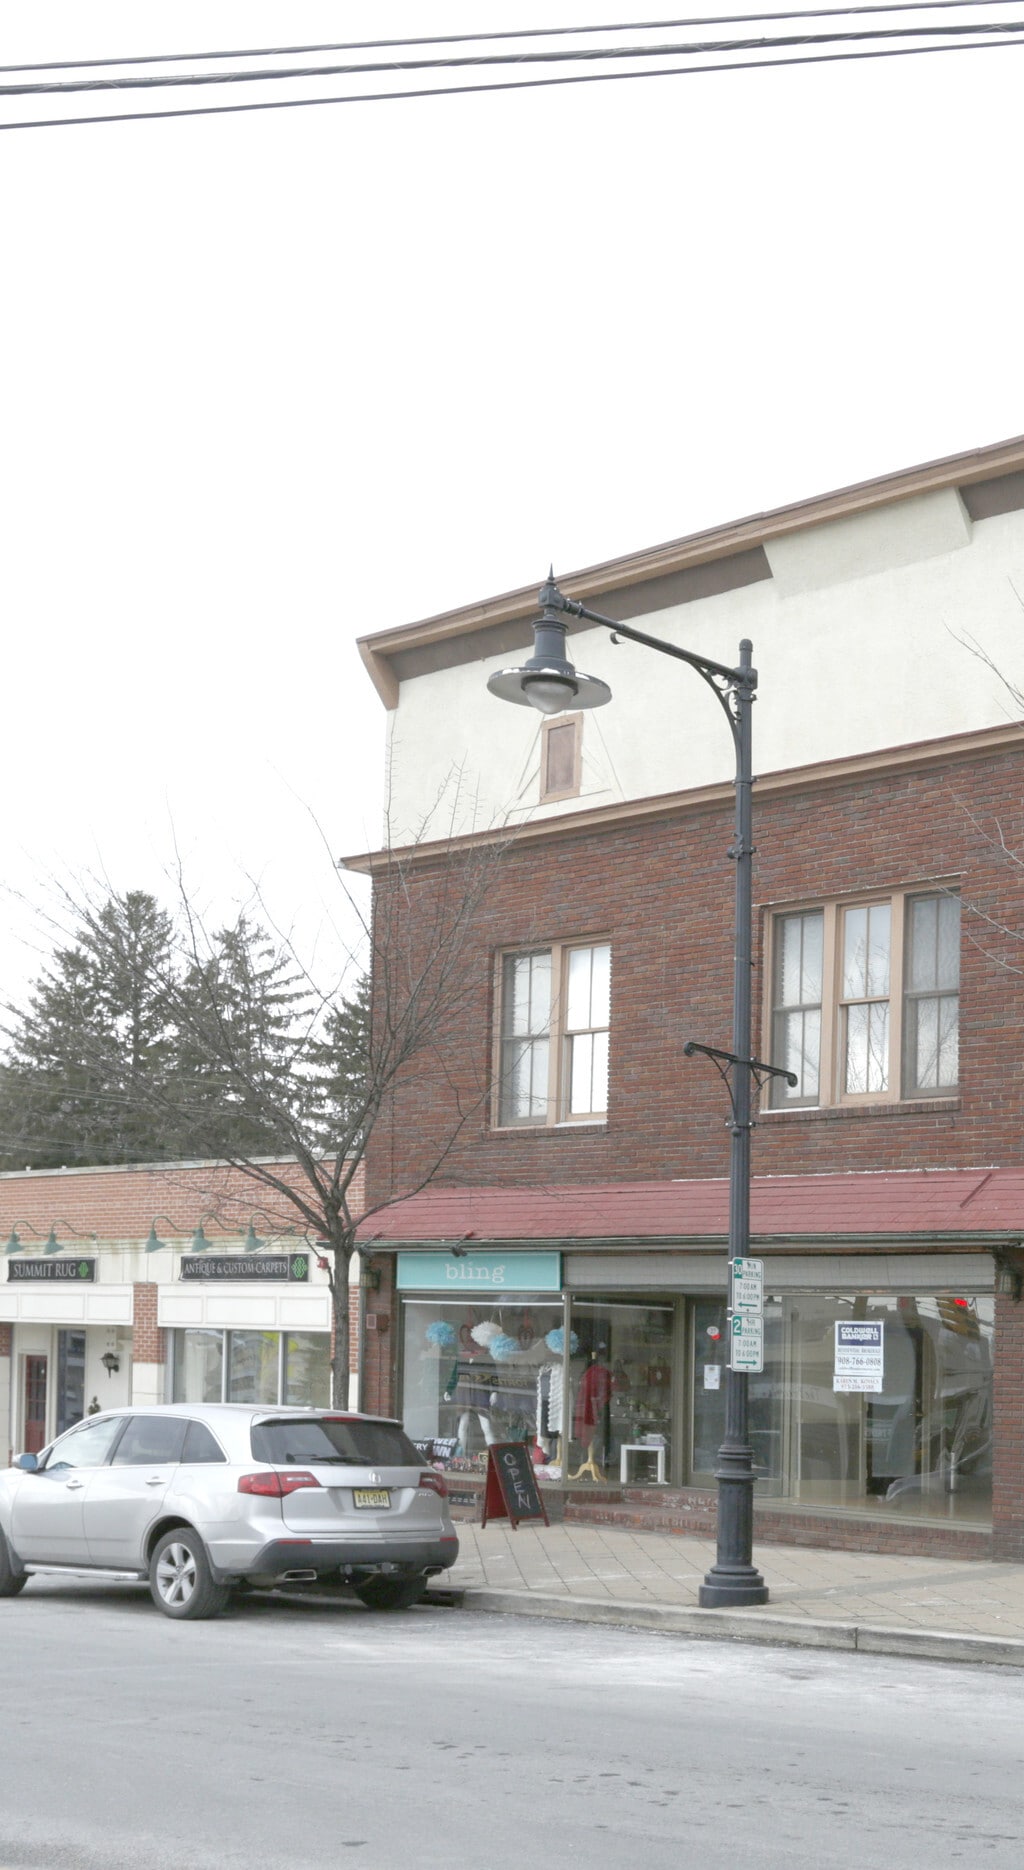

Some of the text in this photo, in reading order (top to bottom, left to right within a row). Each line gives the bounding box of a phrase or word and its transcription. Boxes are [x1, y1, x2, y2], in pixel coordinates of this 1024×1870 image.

[13, 1263, 76, 1277] SUMMIT RUG
[184, 1261, 287, 1275] ANTIQUE & CUSTOM CARPETS
[444, 1261, 506, 1284] bling
[734, 1263, 743, 1274] 30
[742, 1271, 762, 1279] PARKING
[733, 1319, 741, 1334] 2
[741, 1327, 761, 1335] PARKING
[841, 1333, 872, 1341] BANKER
[503, 1453, 531, 1509] OPEN
